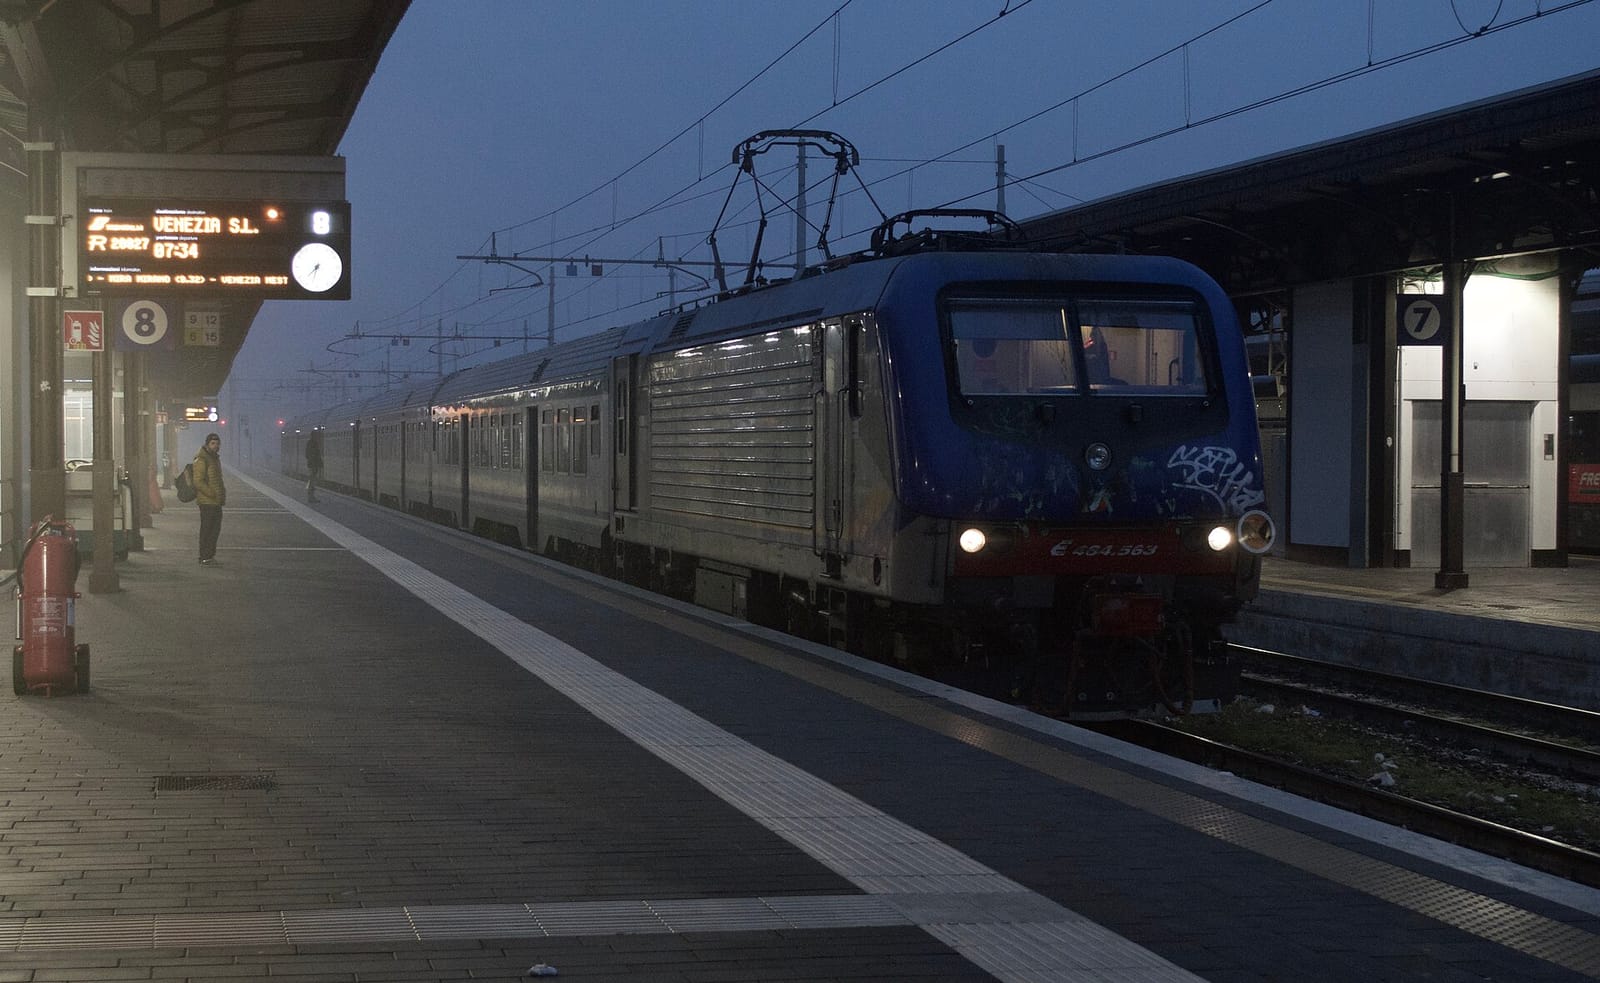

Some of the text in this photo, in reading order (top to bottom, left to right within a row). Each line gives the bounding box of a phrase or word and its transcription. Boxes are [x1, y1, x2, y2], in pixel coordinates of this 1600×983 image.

[153, 216, 221, 234] VENEZIA
[88, 234, 108, 251] R
[153, 242, 199, 259] 07:34
[220, 275, 261, 285] VENEZIA
[134, 307, 156, 337] 8
[205, 315, 217, 325] 12
[1413, 307, 1433, 333] 7
